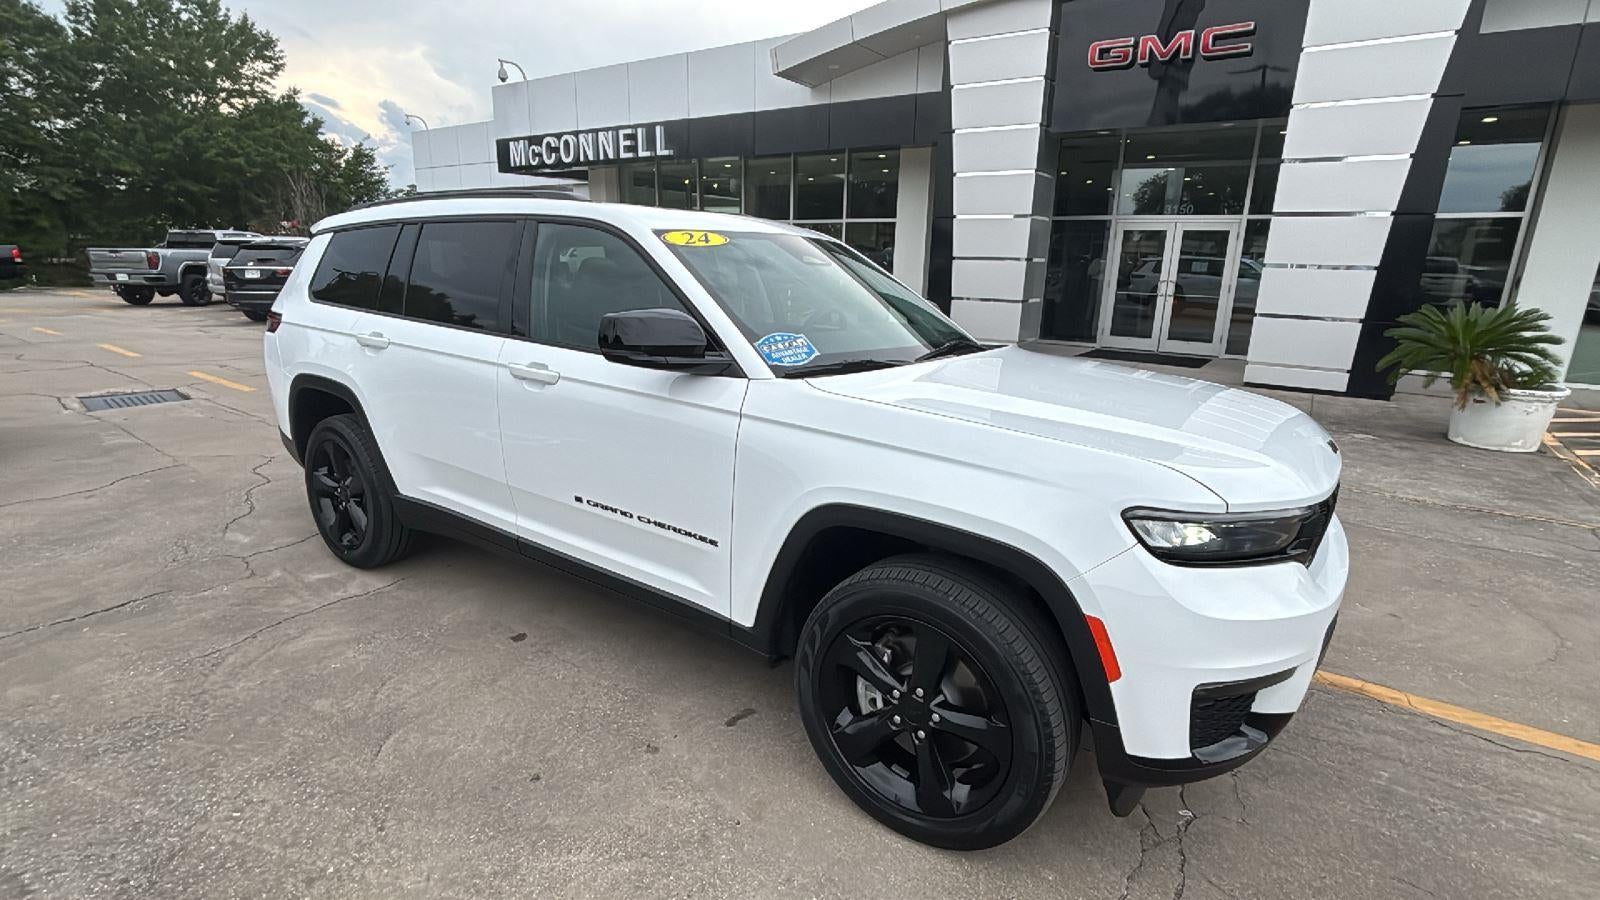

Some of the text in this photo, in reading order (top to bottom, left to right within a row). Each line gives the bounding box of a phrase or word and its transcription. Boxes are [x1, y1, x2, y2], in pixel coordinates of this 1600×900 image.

[1088, 21, 1256, 69] GMC
[509, 125, 674, 167] McCONNELL
[1164, 204, 1194, 215] 3150
[681, 232, 710, 244] 24
[586, 499, 719, 547] GRAND CHEROKEE
